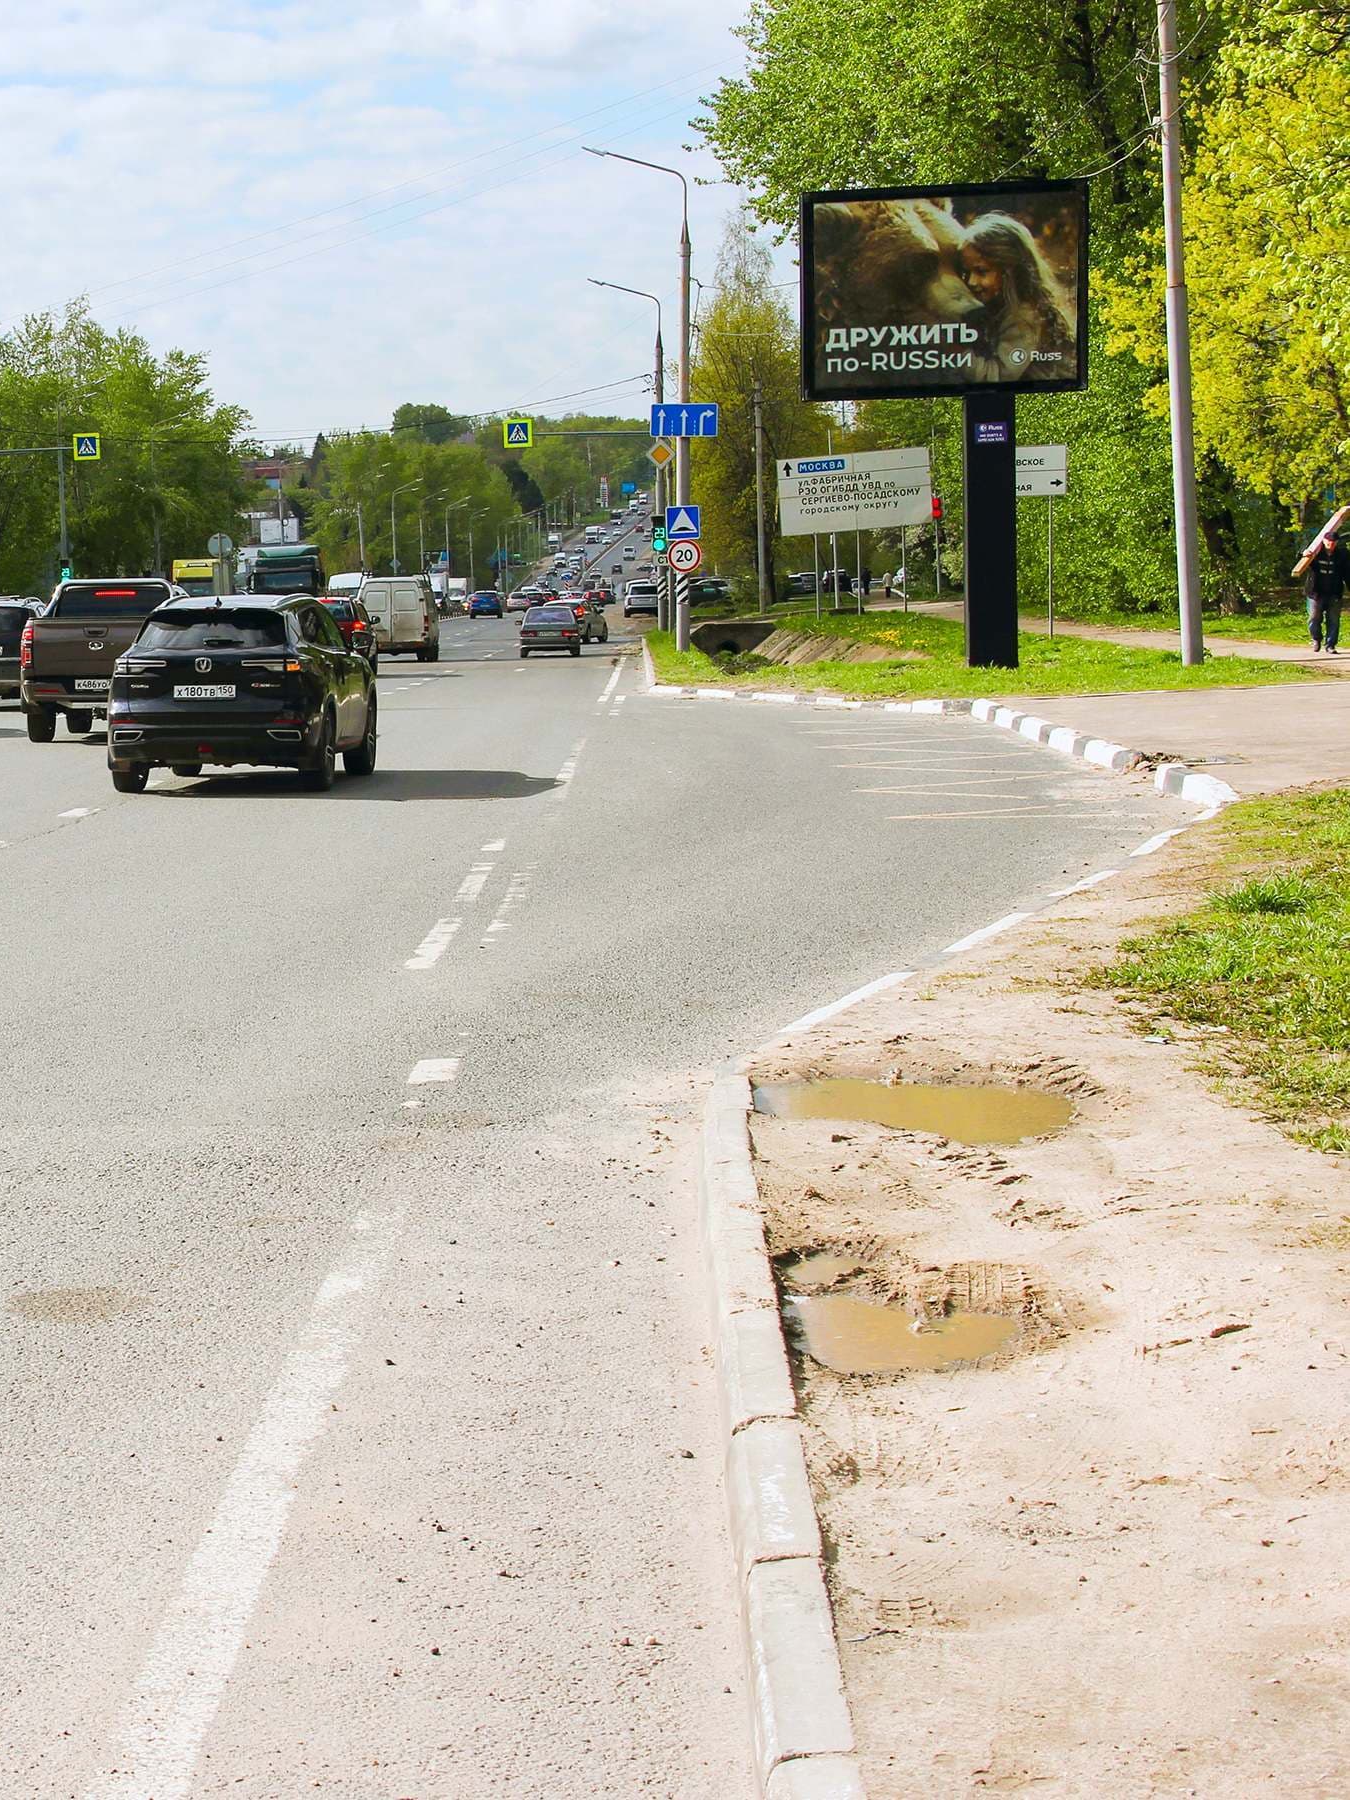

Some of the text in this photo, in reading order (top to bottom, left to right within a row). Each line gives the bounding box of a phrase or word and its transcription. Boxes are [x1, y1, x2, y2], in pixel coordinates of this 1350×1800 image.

[825, 323, 979, 352] ДРУЖИТЬ
[827, 350, 972, 373] по-RUSSки
[1030, 350, 1062, 361] Russ
[799, 461, 844, 473] МОСКВА
[798, 481, 896, 496] РЭО ОГИБДД УВД по
[801, 487, 921, 506] СЕРГИЕВО-ПОСАДСКОМУ
[800, 500, 899, 516] городскому округу
[676, 549, 693, 563] 20
[217, 685, 233, 695] 150
